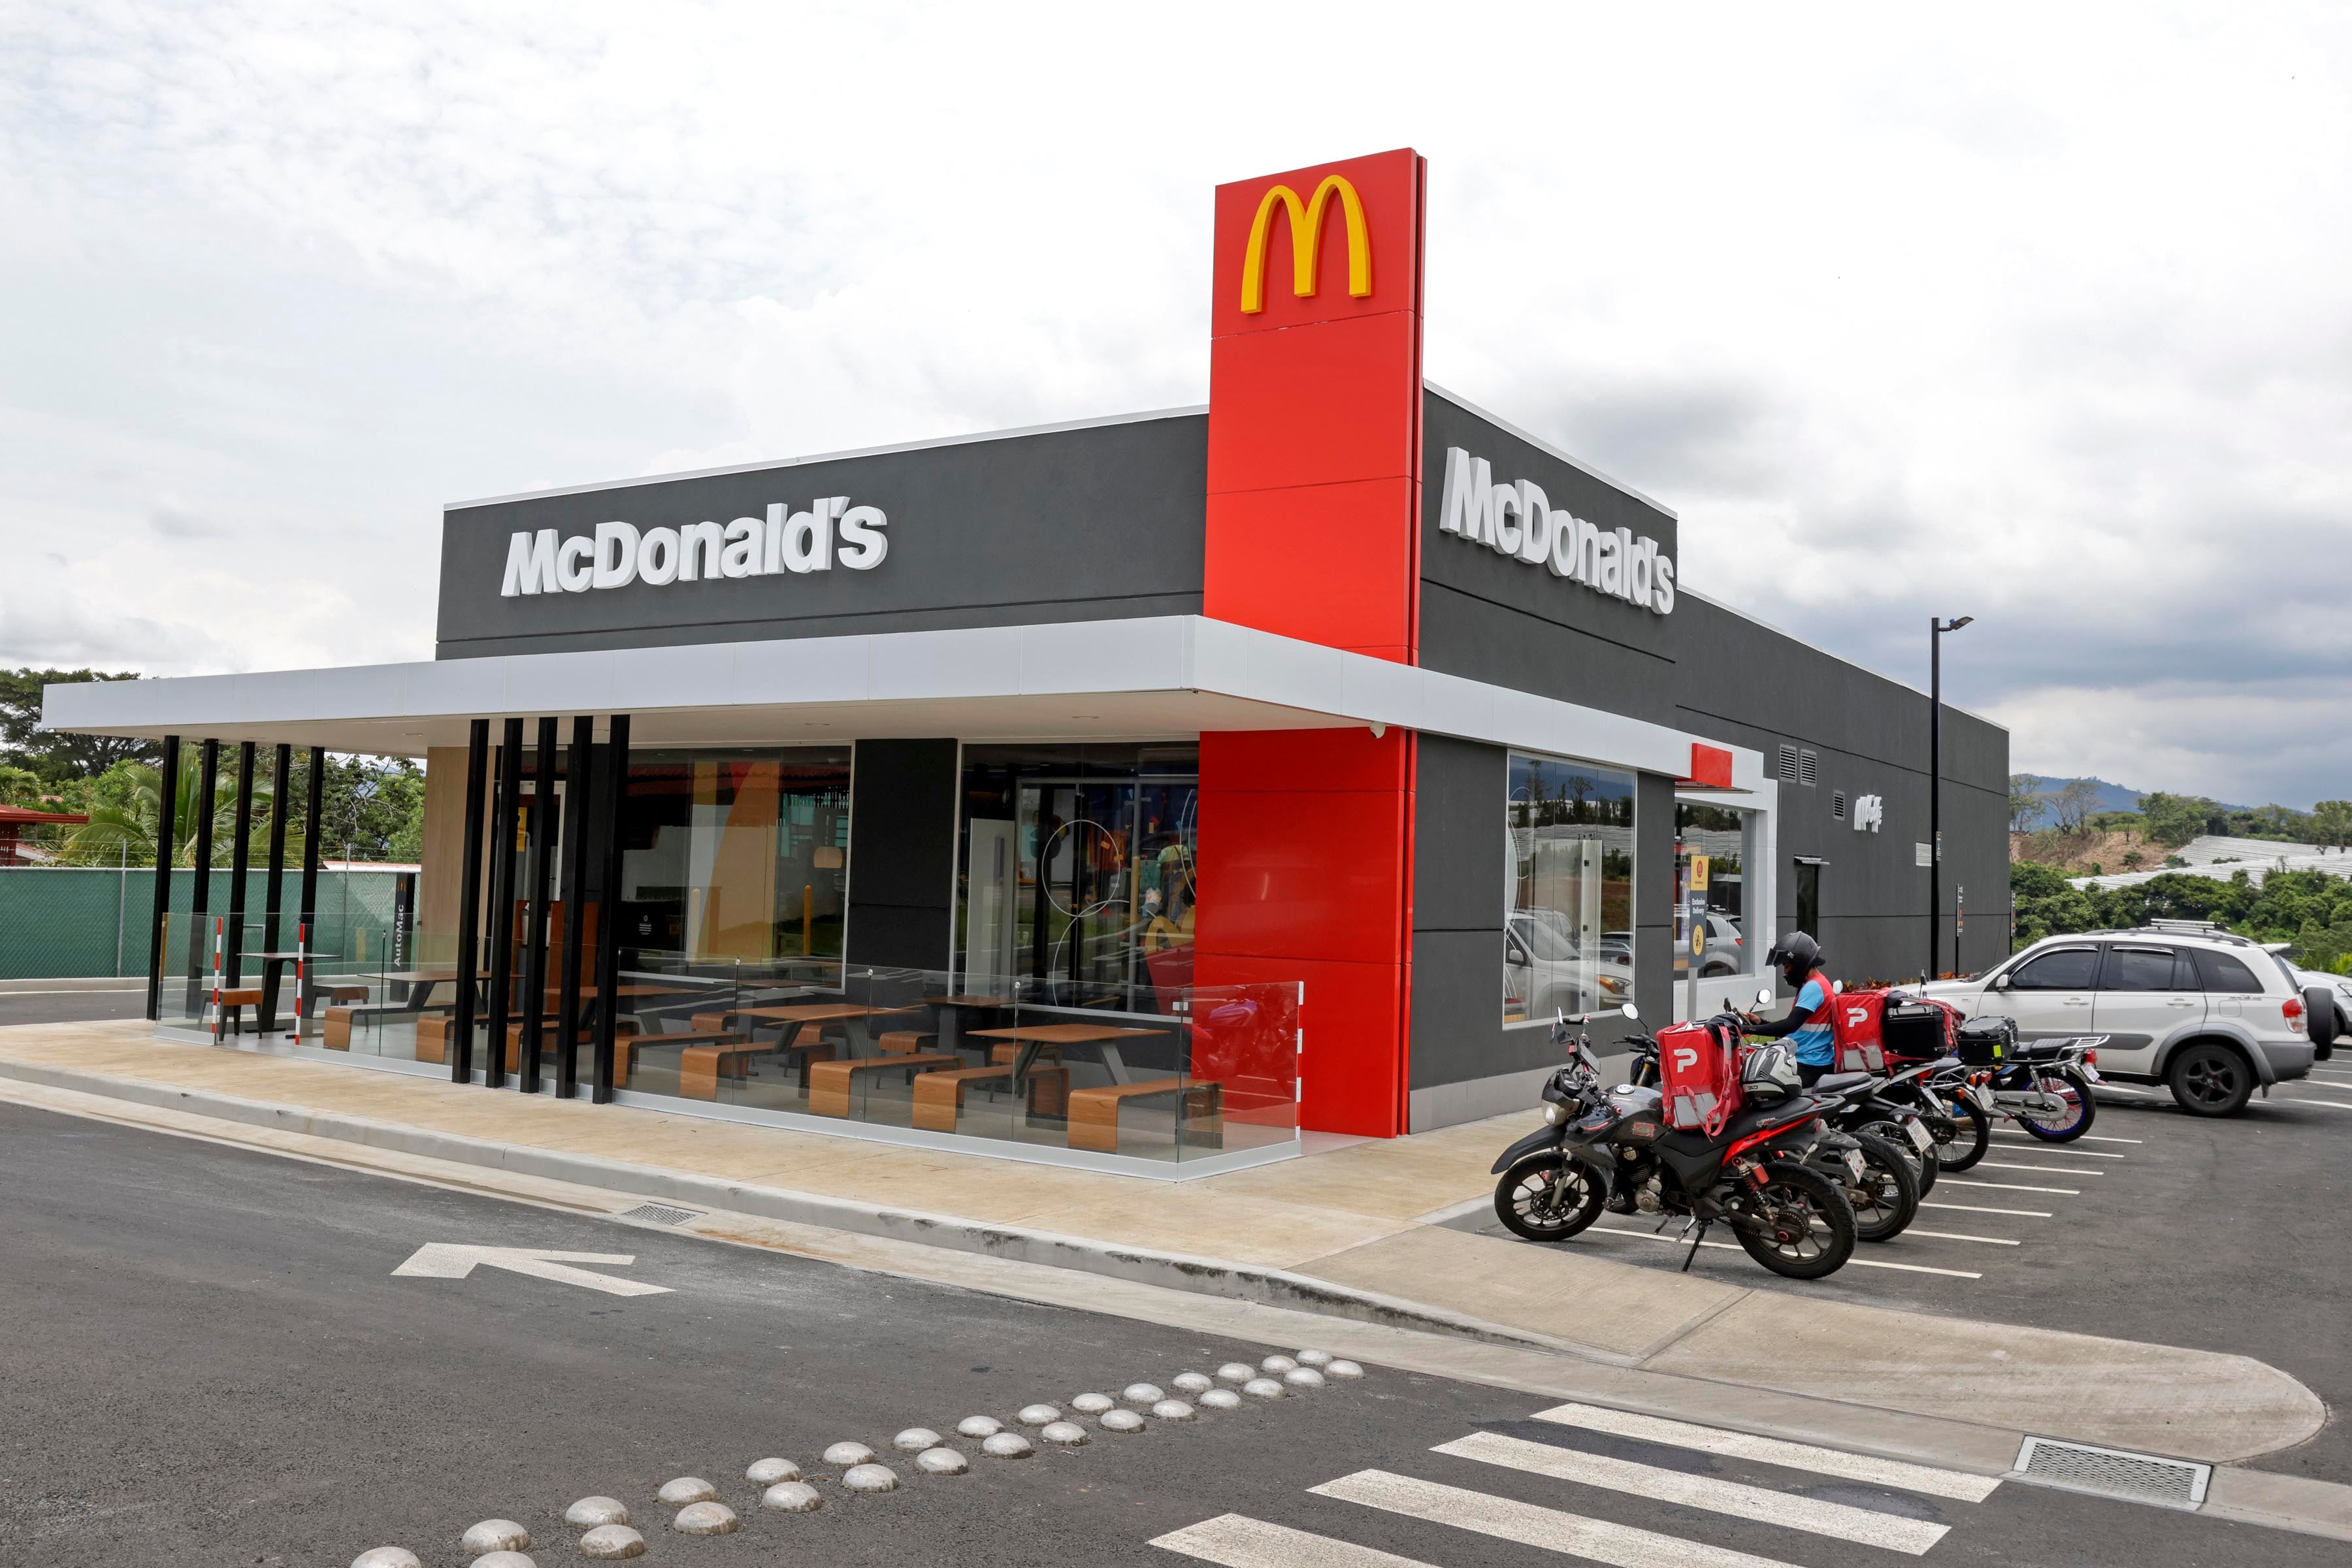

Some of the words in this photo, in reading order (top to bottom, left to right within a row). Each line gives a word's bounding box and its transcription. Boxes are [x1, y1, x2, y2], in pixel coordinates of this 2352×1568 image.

[500, 497, 888, 597] McDonald's
[1439, 447, 1674, 615] McDonald's
[394, 904, 404, 967] AutoMac
